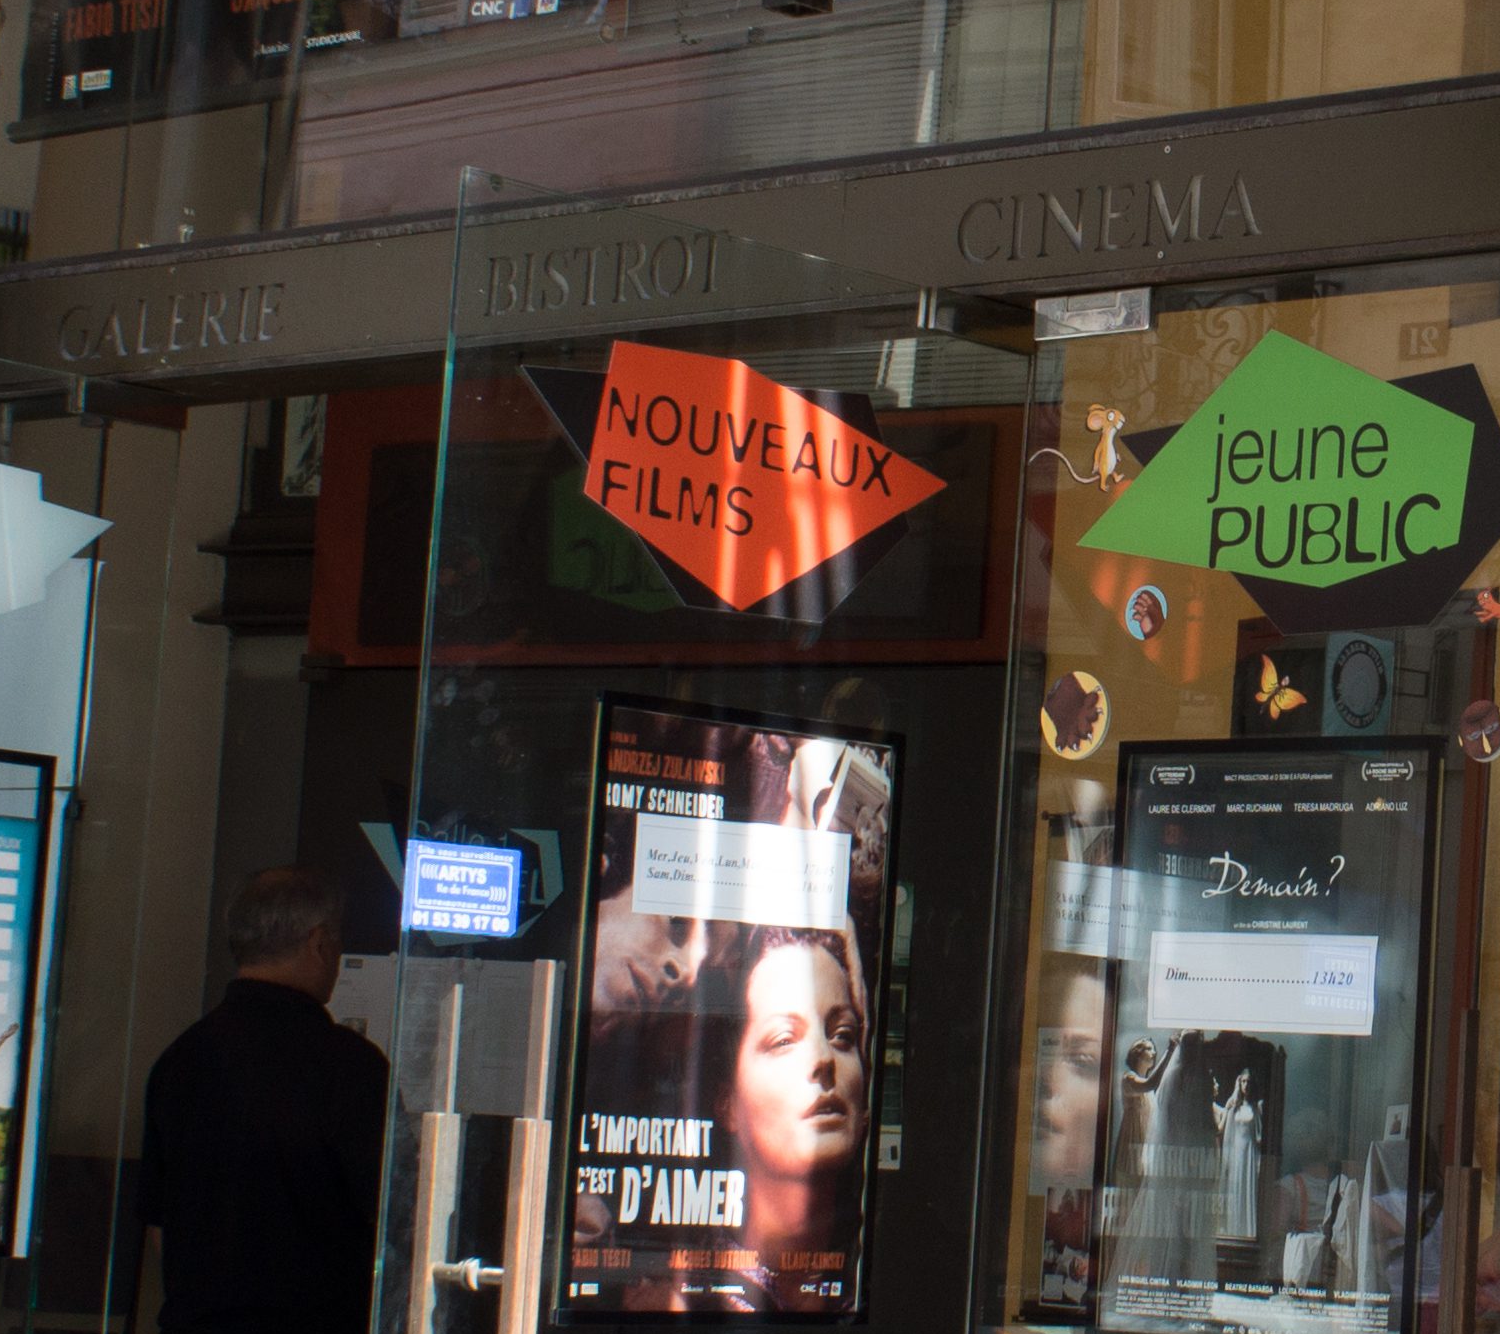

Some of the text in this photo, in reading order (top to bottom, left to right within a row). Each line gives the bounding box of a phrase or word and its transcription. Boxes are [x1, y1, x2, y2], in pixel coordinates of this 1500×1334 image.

[470, 0, 504, 17] CNC
[955, 168, 1264, 267] CINEMA
[484, 230, 733, 320] BISTROT
[56, 282, 286, 363] GALERIE
[607, 386, 892, 497] NOUVEAUX
[1207, 414, 1390, 504] jeune
[603, 461, 755, 536] FILMS
[1207, 494, 1441, 570] PUBLIC
[648, 787, 724, 819] SCHNEIDER
[1148, 804, 1216, 814] LAURE DE CLERMONT
[1227, 803, 1282, 813] MARC RUCHMANN
[1294, 803, 1354, 812] TERESA MADRUGA
[1365, 802, 1408, 812] ADRIANO LUZ
[1201, 851, 1319, 899] Demain
[1252, 921, 1308, 929] CHRISTINE LAURENT
[579, 1113, 713, 1157] L'IMPORTANT
[577, 1165, 745, 1227] C'EST D'AIMER
